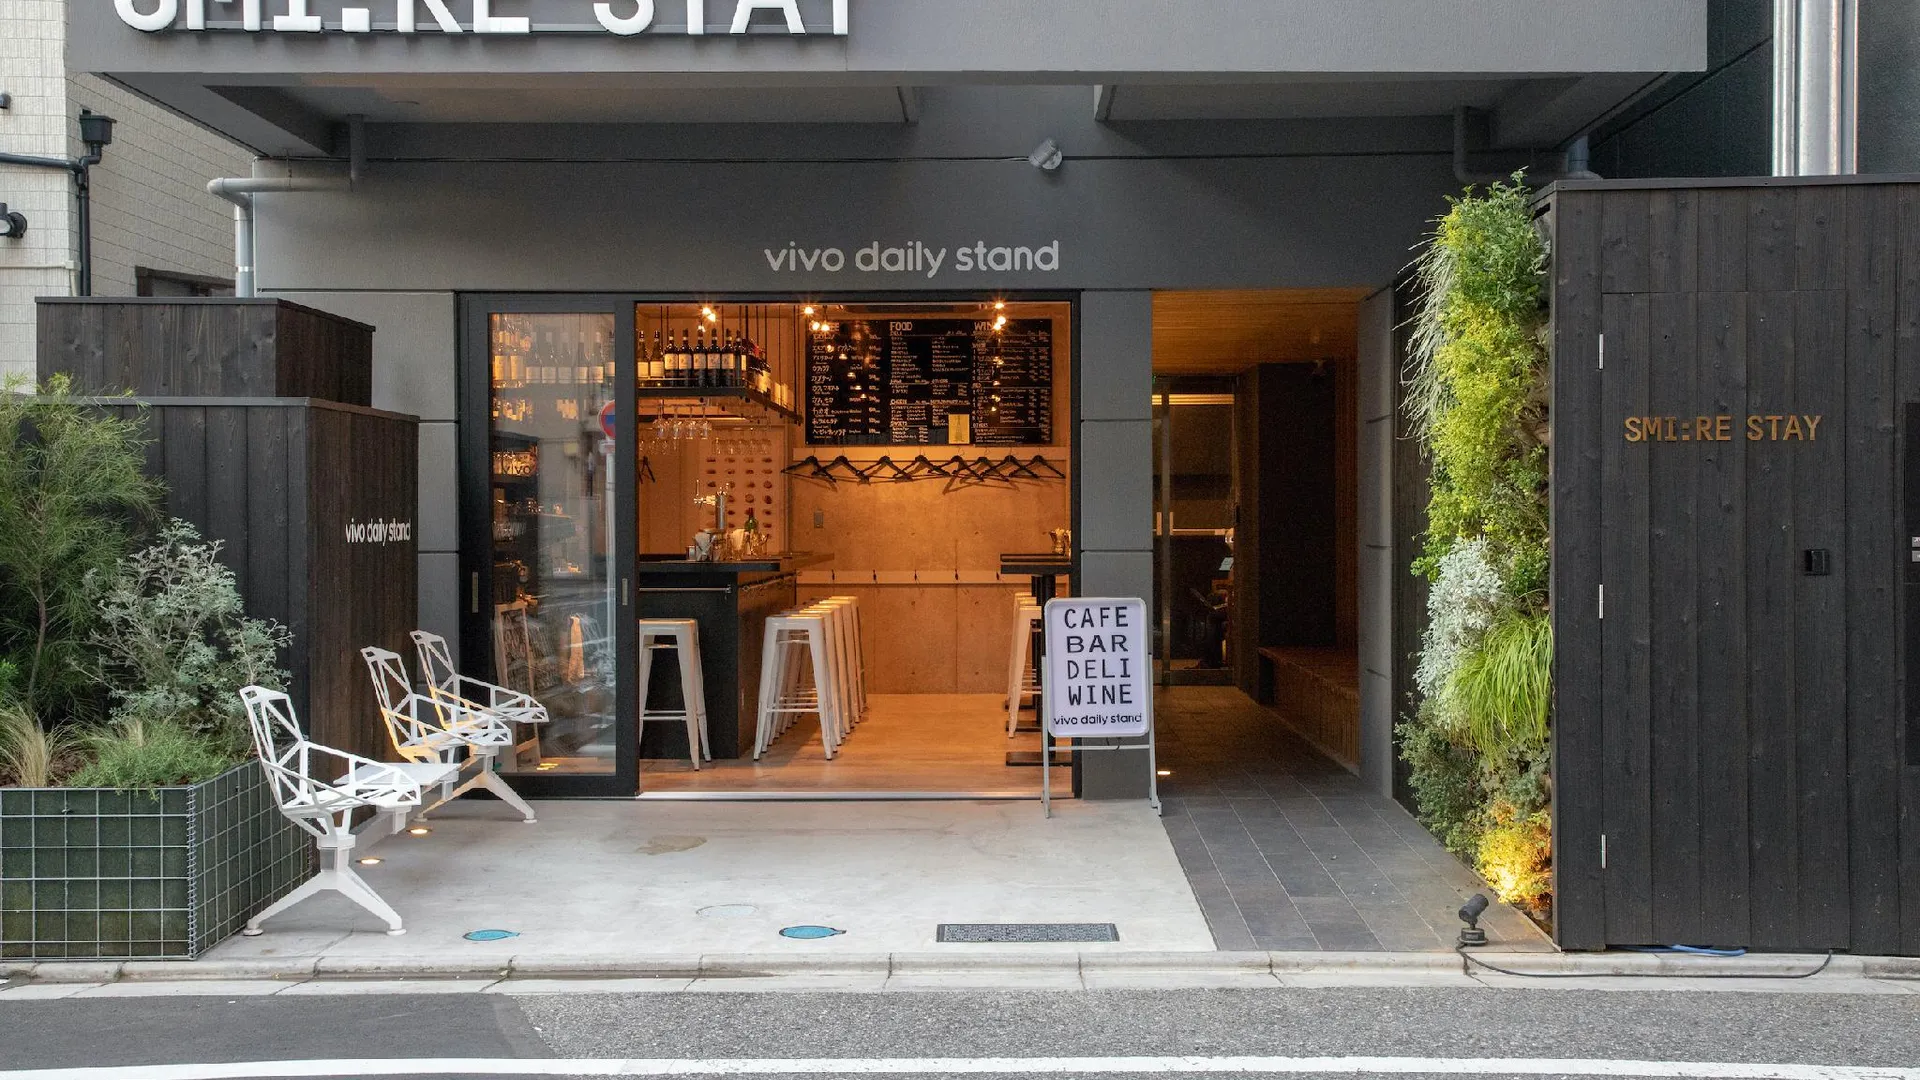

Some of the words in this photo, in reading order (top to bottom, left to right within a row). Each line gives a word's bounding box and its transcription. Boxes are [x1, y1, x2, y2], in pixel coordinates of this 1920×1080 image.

[764, 240, 845, 272] vivo
[855, 240, 947, 278] daily
[955, 239, 1059, 271] stand
[889, 321, 913, 331] FOOD
[1624, 415, 1732, 442] SMI:RE
[1746, 415, 1822, 441] STAY
[345, 517, 366, 543] vivo
[366, 517, 388, 547] daily
[388, 517, 411, 542] stand
[1064, 606, 1128, 629] CAFE
[1066, 634, 1129, 653] BAR
[1067, 658, 1131, 679] DELI
[1068, 683, 1133, 706] WINE
[1054, 715, 1078, 725] vivo
[1080, 714, 1108, 726] daily
[1110, 713, 1142, 724] stand
